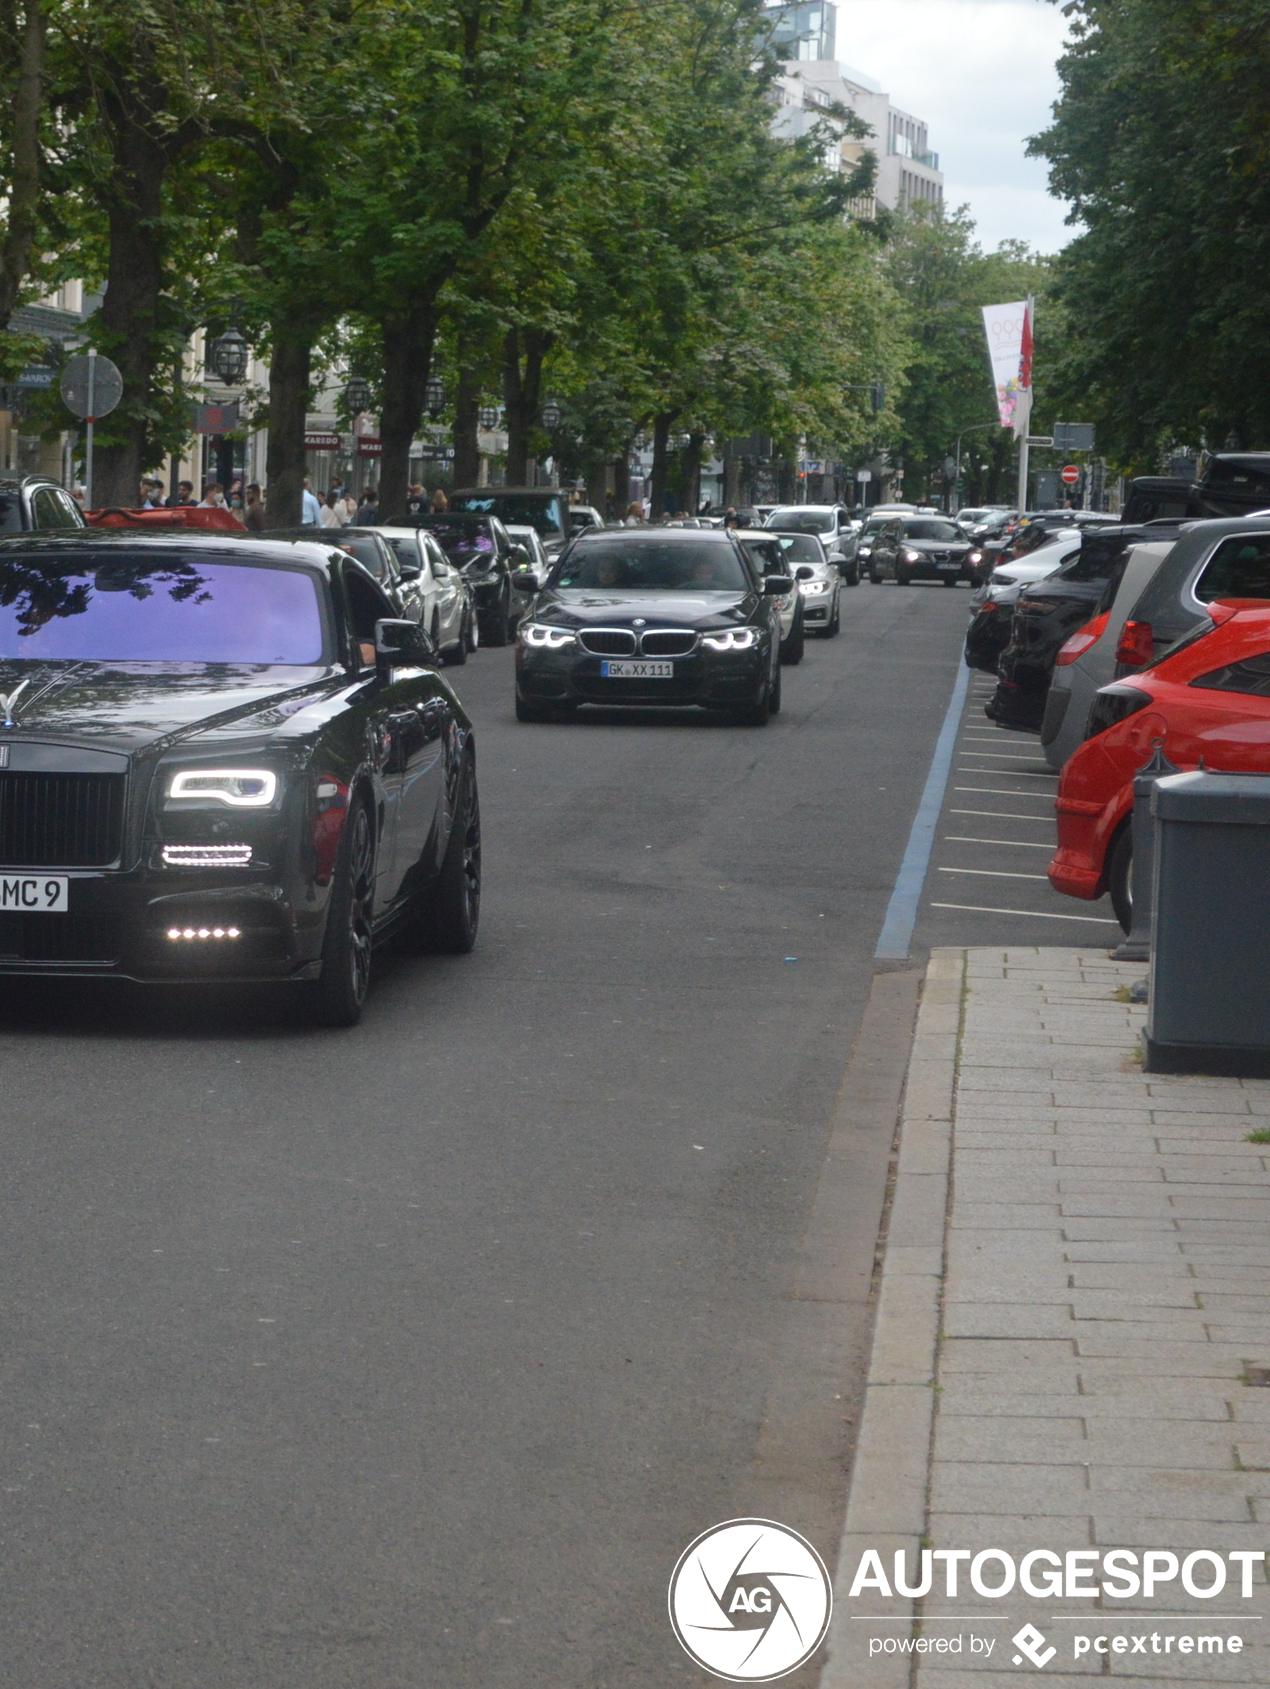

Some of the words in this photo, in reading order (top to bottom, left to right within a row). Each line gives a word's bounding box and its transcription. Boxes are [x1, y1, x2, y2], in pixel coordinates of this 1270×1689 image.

[609, 663, 624, 675] GK
[632, 664, 648, 676] XX
[650, 665, 671, 676] 111
[2, 879, 39, 907] MC
[44, 880, 61, 907] 9
